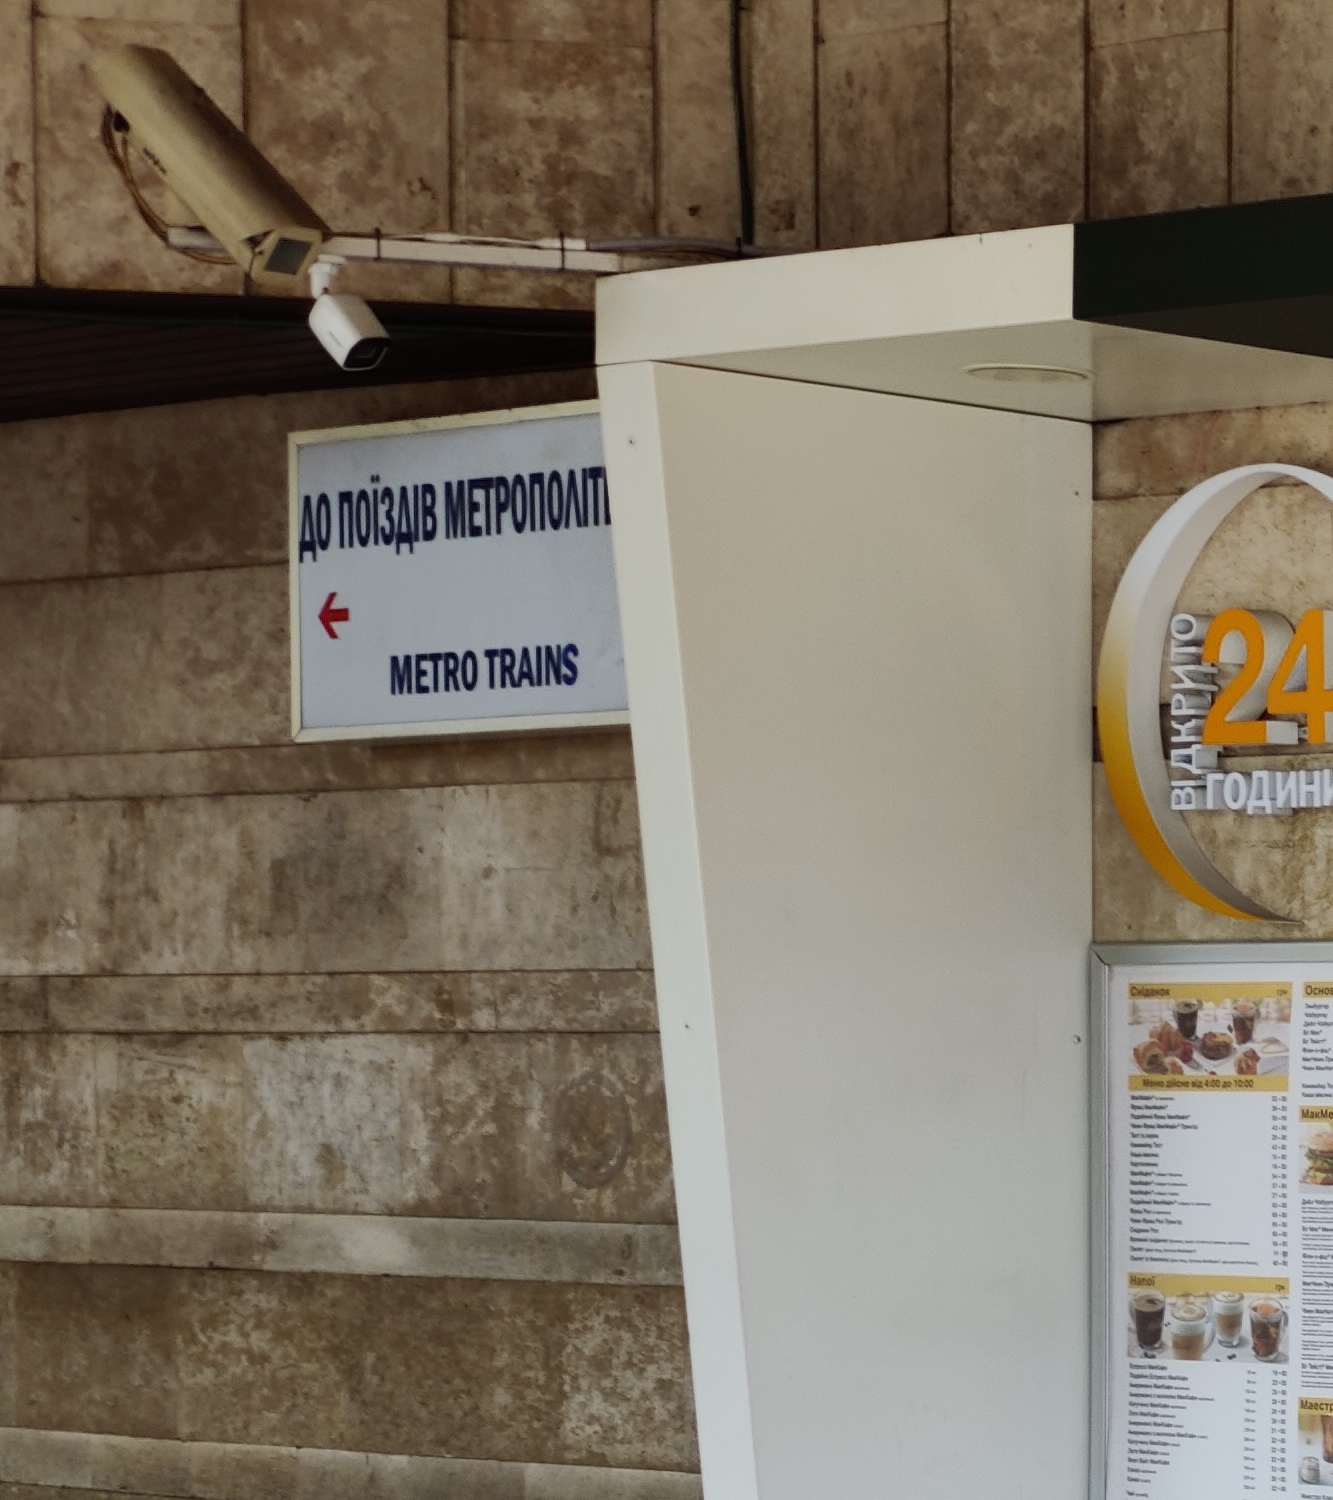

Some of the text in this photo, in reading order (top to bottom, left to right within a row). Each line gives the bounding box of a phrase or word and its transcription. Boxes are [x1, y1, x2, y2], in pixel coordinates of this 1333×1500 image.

[299, 492, 331, 563] ДО
[338, 474, 438, 555] ПОЇЗДІВ
[390, 643, 579, 696] METRO TRAINS
[1170, 612, 1201, 811] ВІДКРИТО
